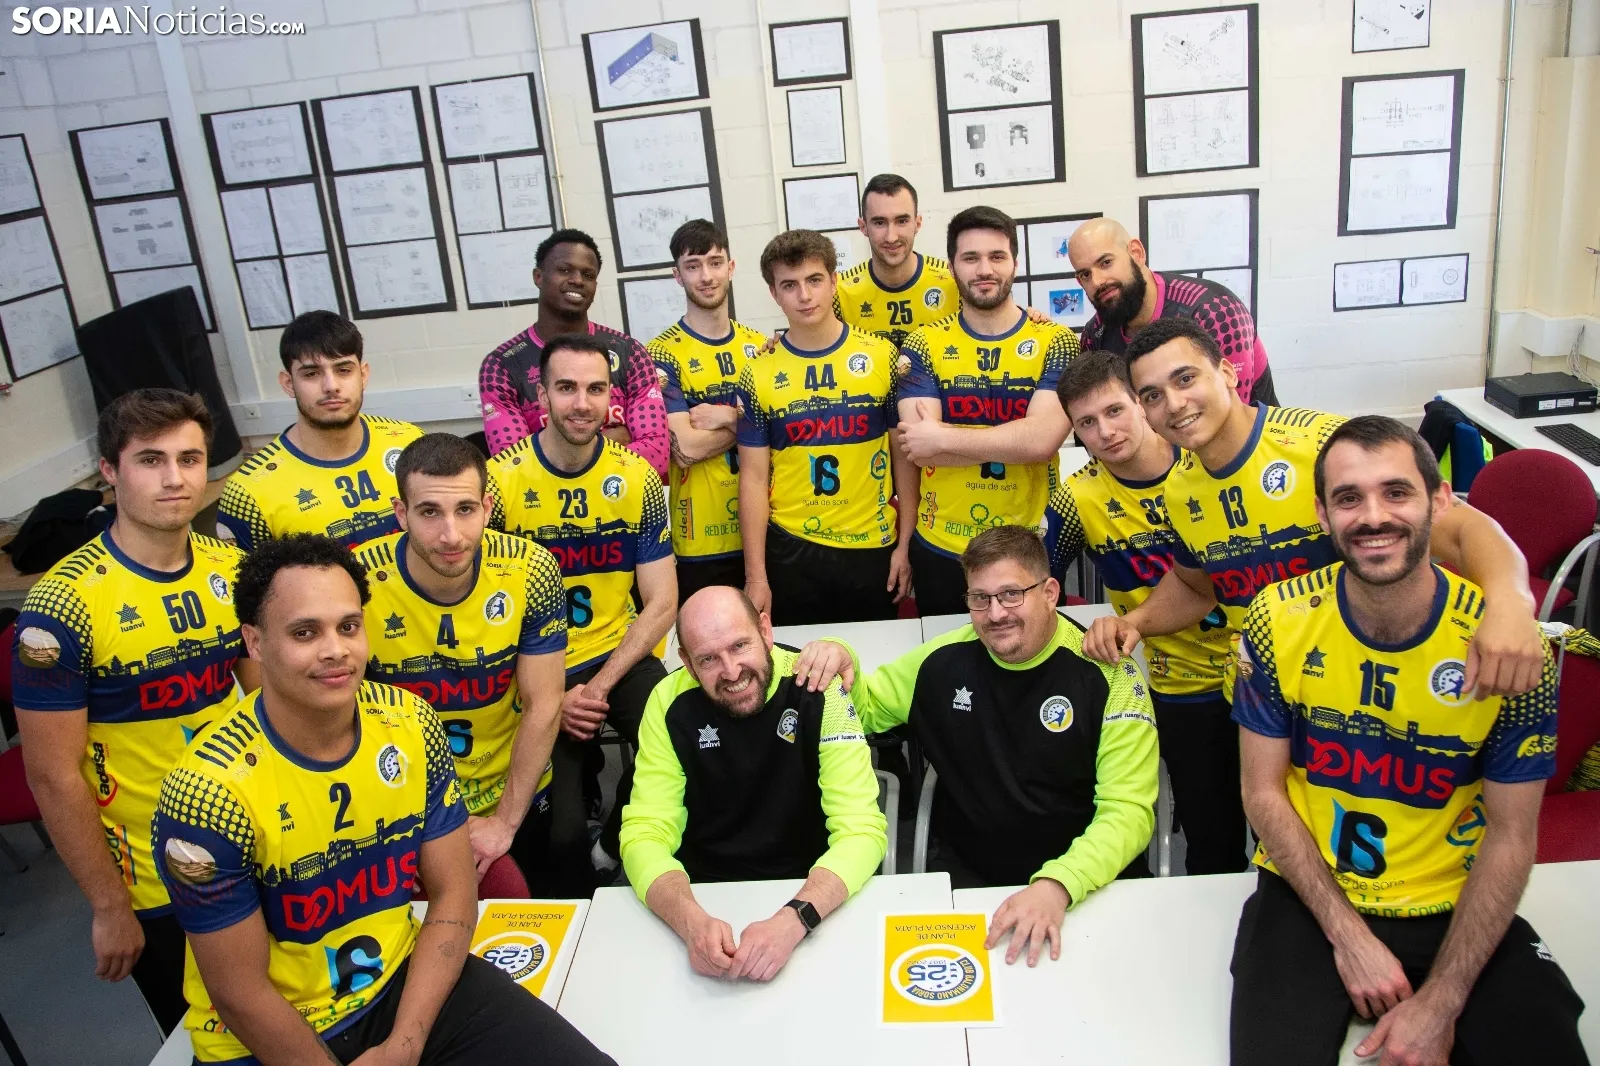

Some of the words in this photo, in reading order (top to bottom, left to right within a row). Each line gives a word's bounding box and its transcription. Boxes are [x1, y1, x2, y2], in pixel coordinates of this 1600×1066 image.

[887, 300, 913, 325] 25
[715, 352, 736, 377] 18
[977, 347, 1001, 371] 30
[805, 364, 837, 391] 44
[785, 414, 869, 441] DOMUS
[335, 470, 380, 508] 34
[965, 481, 986, 490] agua
[988, 482, 999, 490] de
[558, 488, 588, 518] 23
[1219, 486, 1248, 529] 13
[705, 525, 720, 536] RED
[720, 523, 730, 535] DE
[945, 521, 961, 535] RED
[963, 524, 973, 537] DE
[549, 541, 622, 569] OMUS
[161, 590, 206, 634] 50
[121, 622, 146, 633] luanvi
[385, 630, 407, 639] luanvi
[437, 613, 459, 649] 4
[392, 669, 512, 705] OMUS
[1359, 659, 1399, 711] 15
[700, 741, 720, 749] luanvi
[470, 751, 492, 765] soria
[1306, 737, 1456, 800] DOMUS
[328, 783, 354, 832] 2
[282, 851, 417, 932] DOMUS
[1352, 881, 1368, 890] de
[512, 961, 542, 979] BALONM
[906, 964, 947, 981] 25
[911, 987, 935, 1000] SORIA
